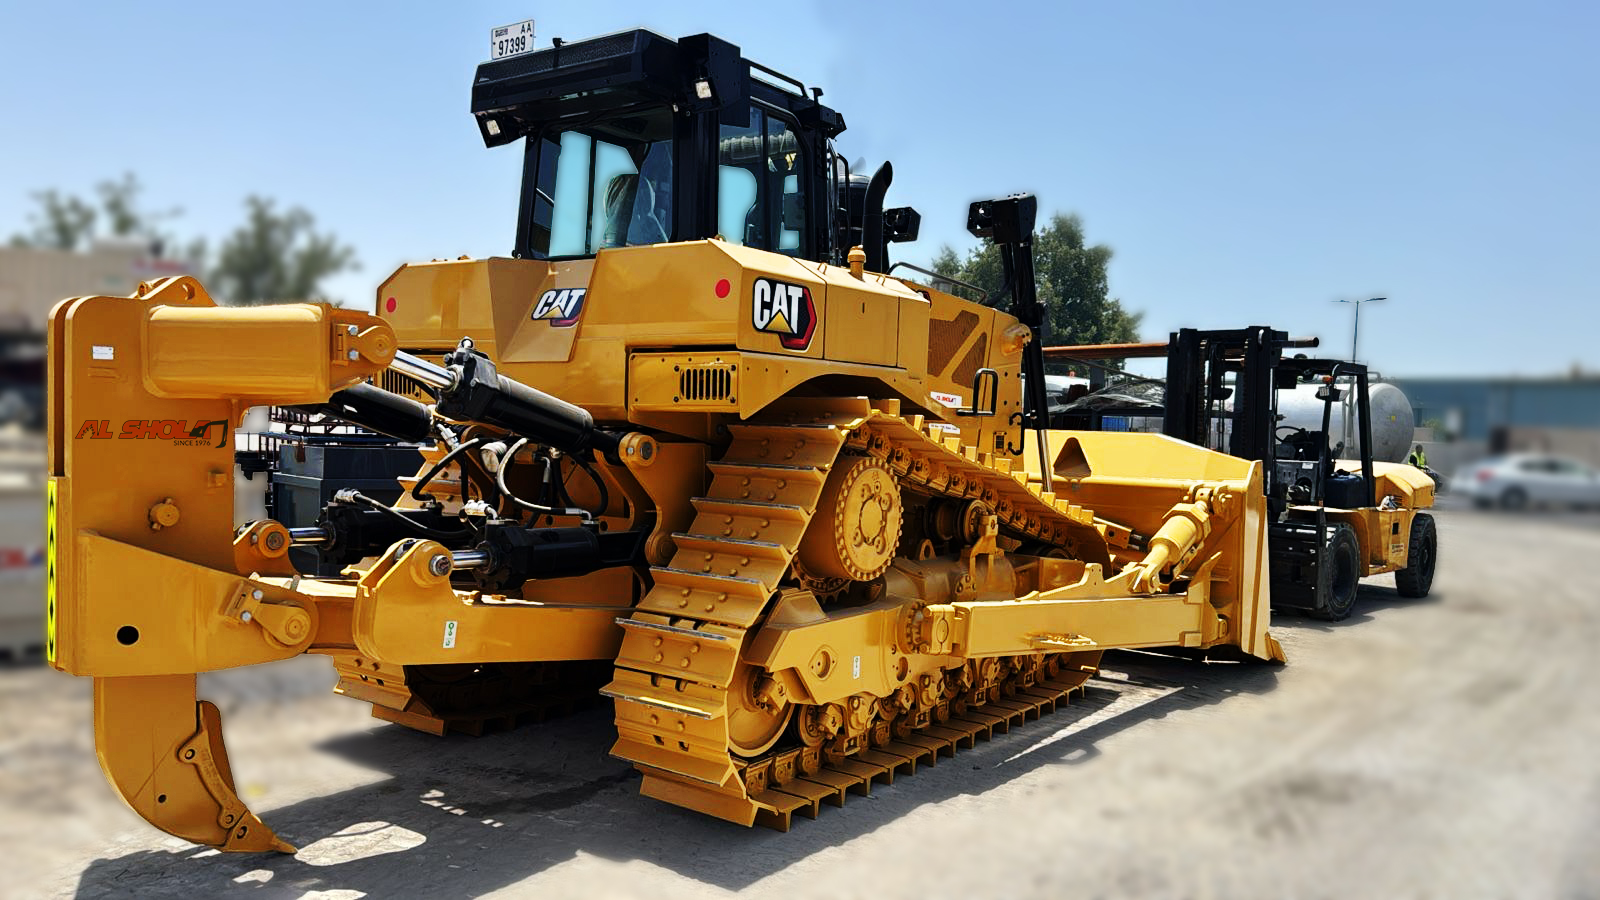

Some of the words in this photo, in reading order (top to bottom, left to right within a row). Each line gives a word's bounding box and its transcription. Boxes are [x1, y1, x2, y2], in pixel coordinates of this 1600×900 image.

[498, 35, 526, 56] 97399
[532, 289, 587, 319] CAT
[753, 279, 803, 334] CAT
[75, 420, 113, 439] AL
[118, 420, 211, 440] SHOLA
